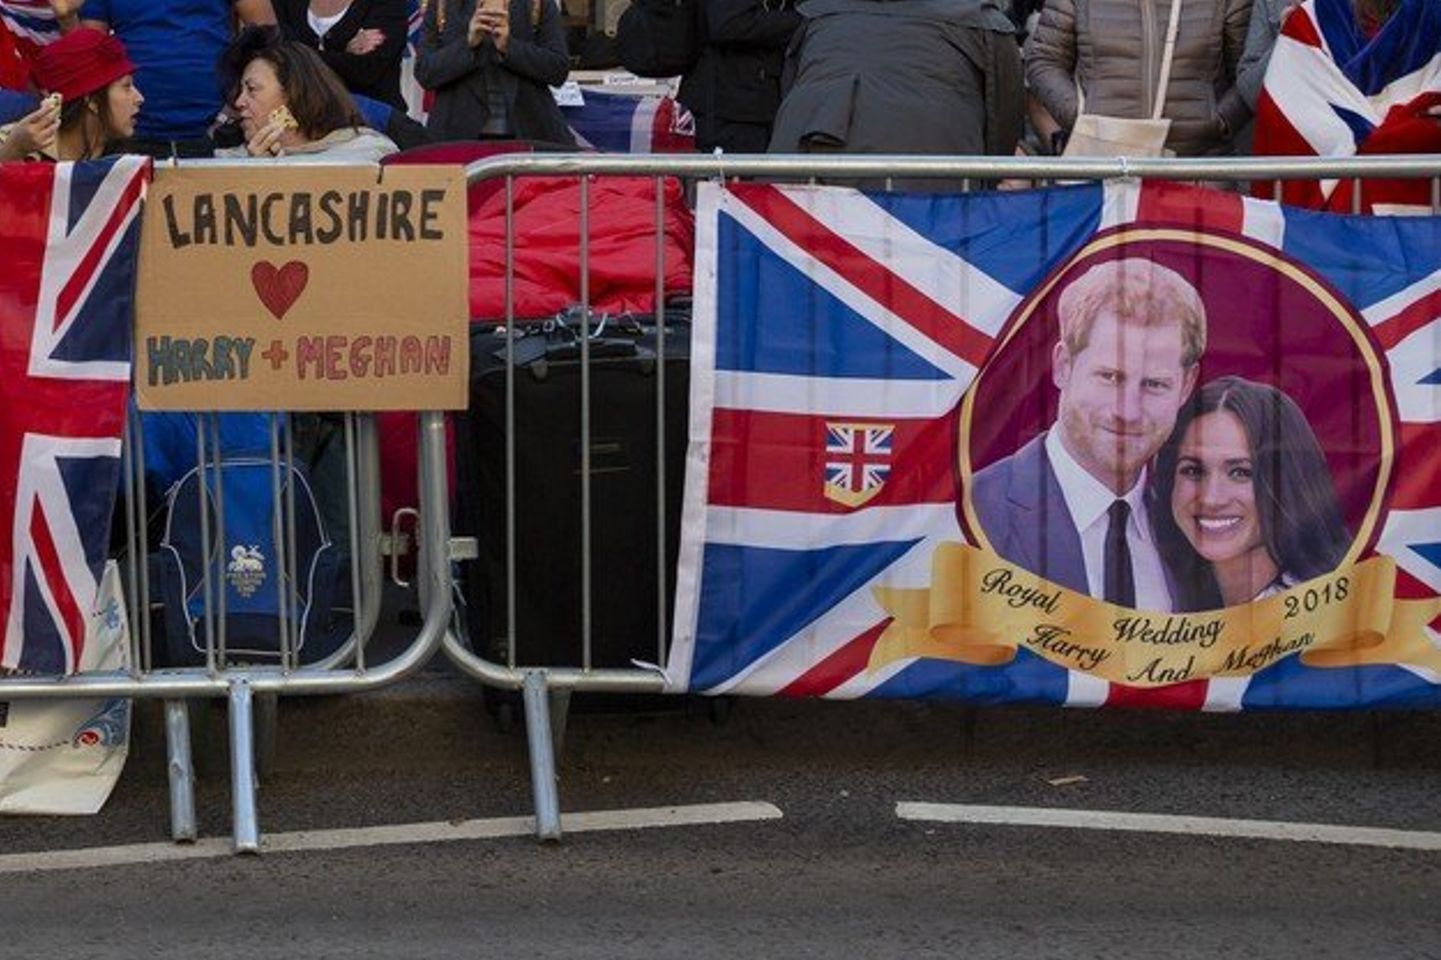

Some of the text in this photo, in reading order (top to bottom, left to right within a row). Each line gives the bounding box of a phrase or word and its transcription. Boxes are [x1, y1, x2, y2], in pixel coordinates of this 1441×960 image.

[162, 189, 447, 249] LANCASHIRE
[146, 335, 256, 386] HARRY
[296, 334, 452, 380] MEGHAN
[980, 567, 1351, 648] Royal Wedding 2018
[1025, 623, 1317, 683] Harry And Meghan
